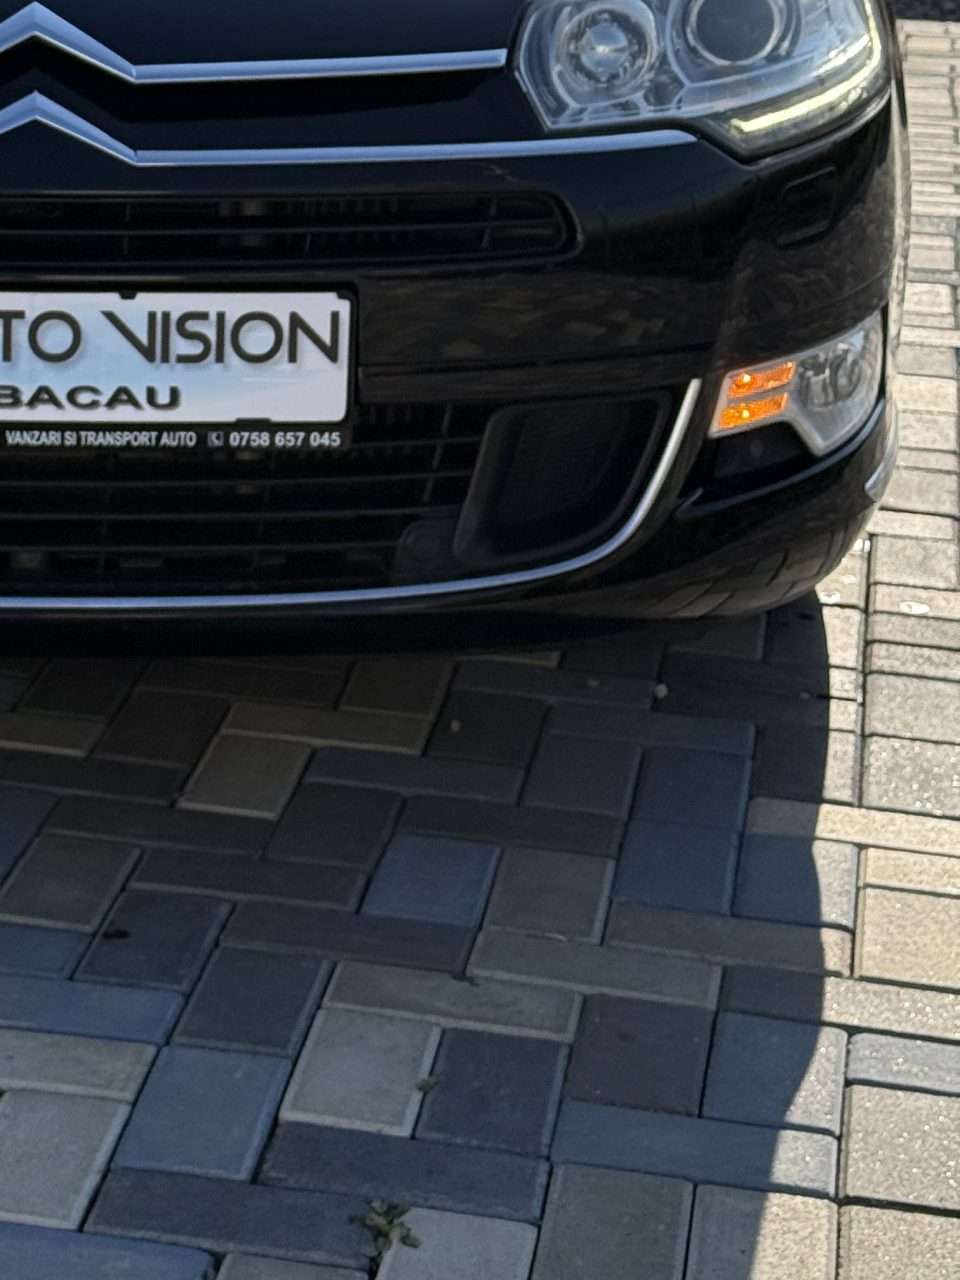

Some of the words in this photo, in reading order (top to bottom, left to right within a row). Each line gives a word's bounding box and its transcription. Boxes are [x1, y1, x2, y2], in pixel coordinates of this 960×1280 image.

[101, 310, 340, 365] VISION
[5, 430, 62, 446] VANZARI
[64, 431, 77, 447] SI
[80, 431, 158, 447] TRANSPORT
[159, 431, 197, 447] AUTO
[229, 431, 271, 448] 0758
[274, 432, 305, 448] 657
[309, 432, 341, 448] 045
